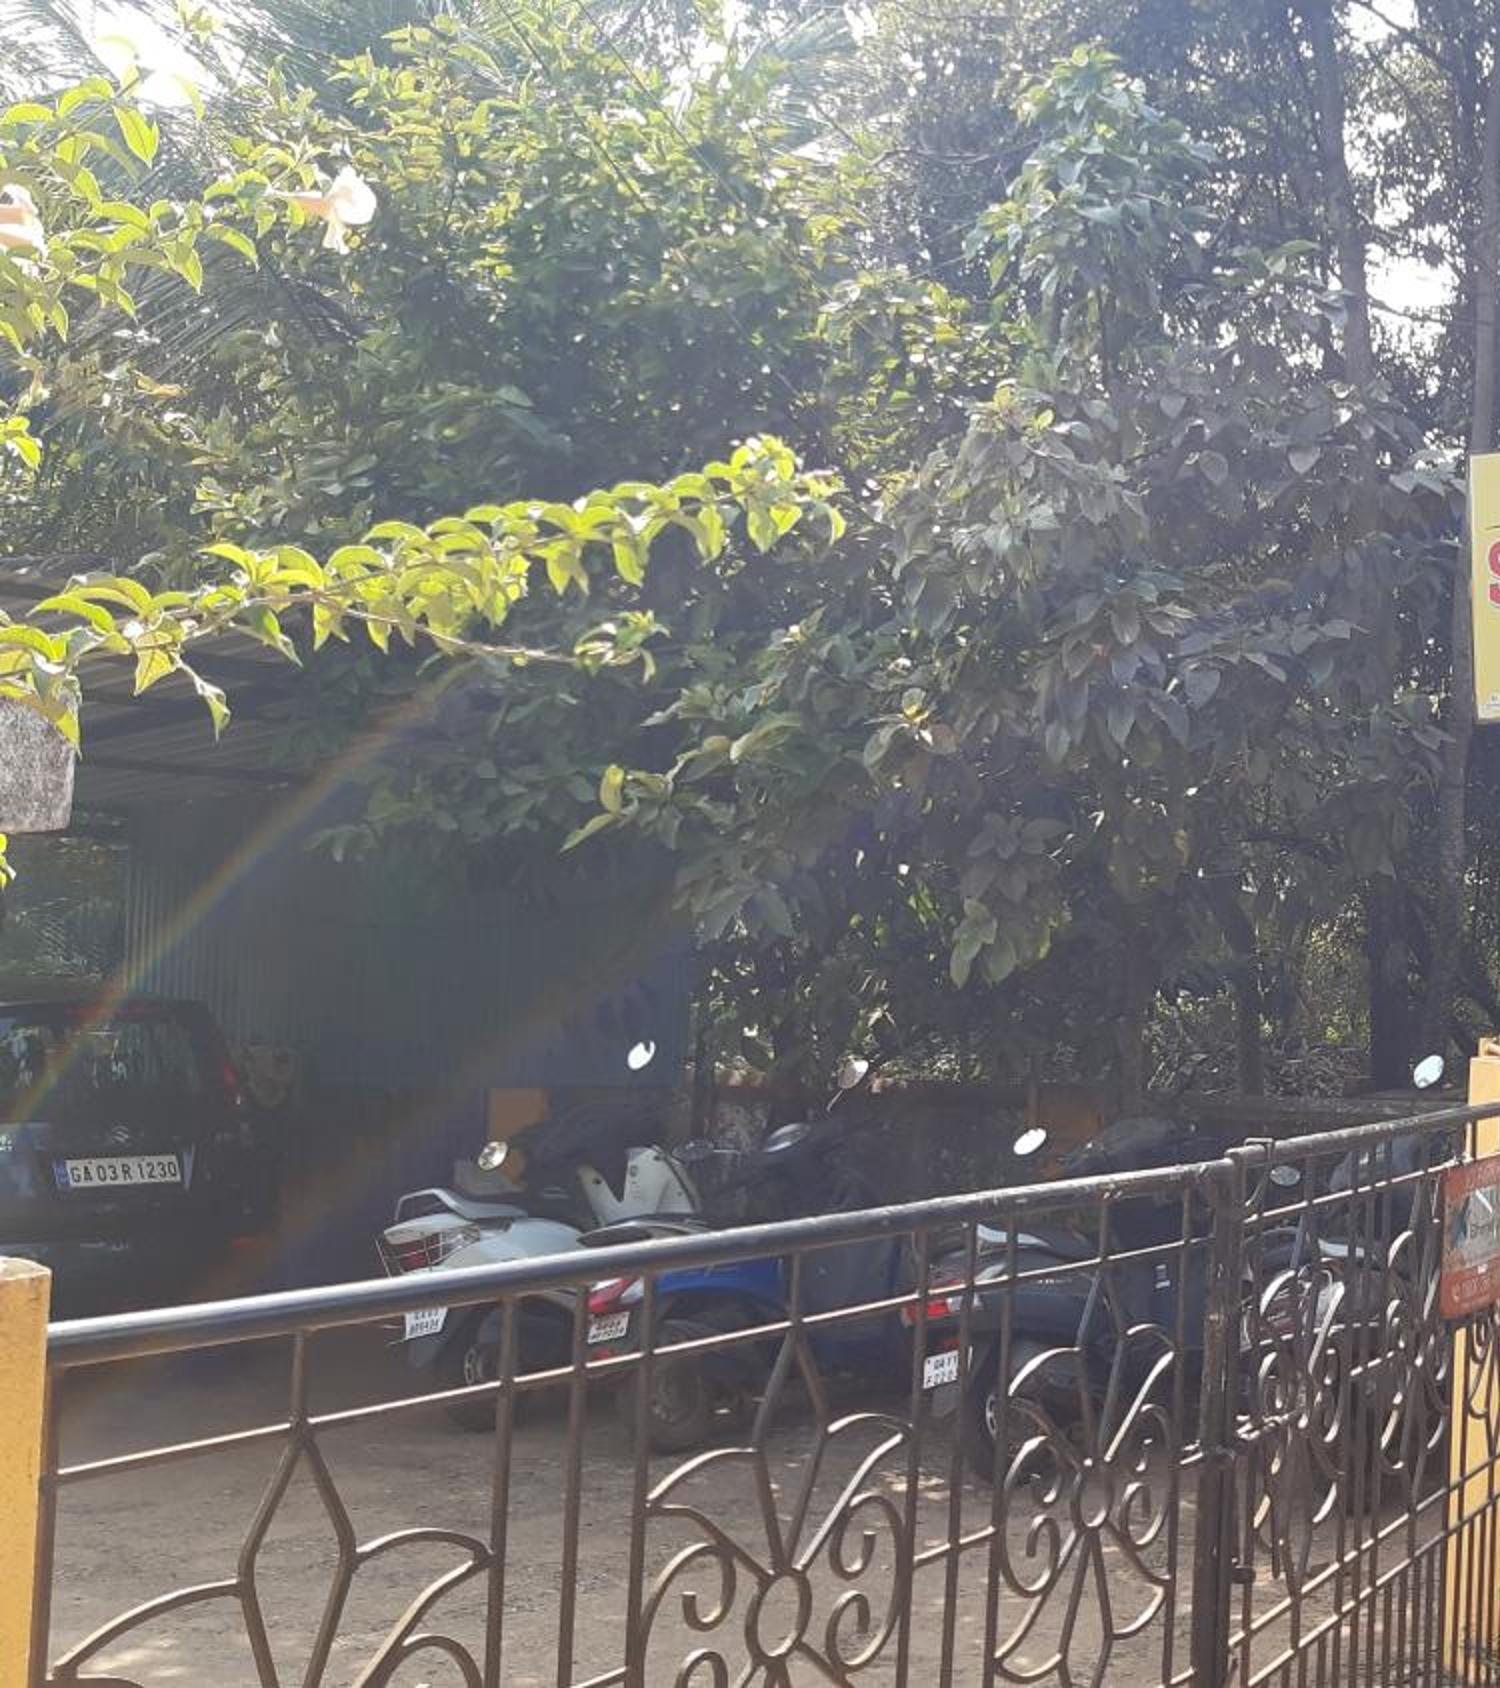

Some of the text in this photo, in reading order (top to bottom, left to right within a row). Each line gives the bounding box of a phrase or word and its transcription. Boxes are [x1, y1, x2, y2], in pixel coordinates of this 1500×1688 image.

[70, 1165, 93, 1183] GA
[96, 1164, 119, 1181] 03
[137, 1161, 177, 1180] 1230
